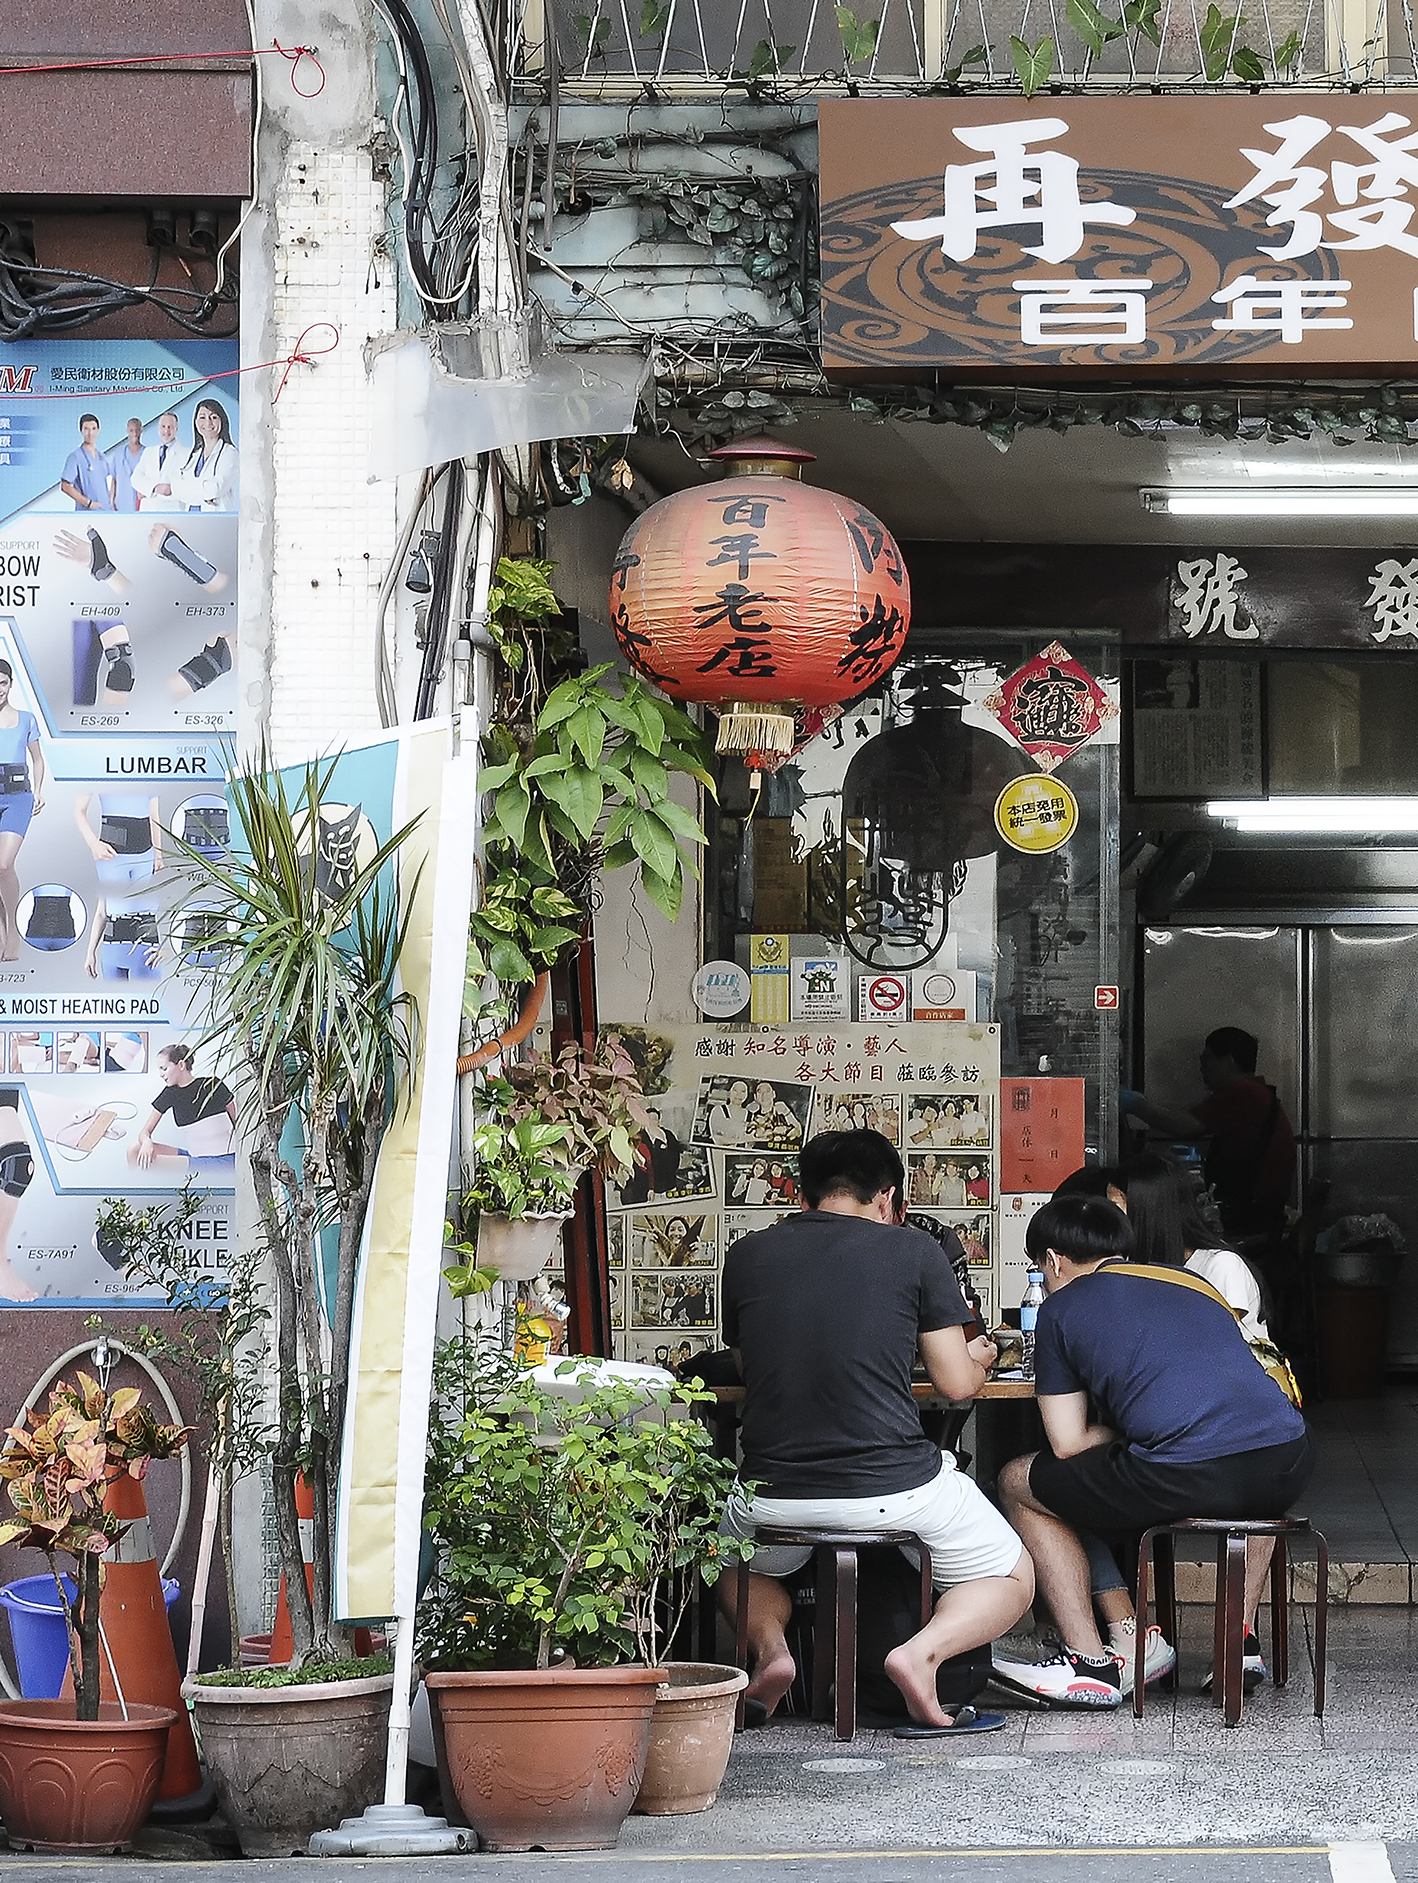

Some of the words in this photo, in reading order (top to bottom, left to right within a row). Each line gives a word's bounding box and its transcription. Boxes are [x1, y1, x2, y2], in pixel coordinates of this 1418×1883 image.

[692, 493, 787, 678] 百年老店
[80, 606, 121, 617] EH-409
[185, 606, 226, 617] EH-373
[80, 715, 120, 726] ES-269
[184, 715, 224, 726] ES-326
[105, 756, 208, 775] LUMBAR
[1006, 797, 1065, 817] 本店免用
[1008, 810, 1068, 829] 統一發票
[12, 998, 58, 1015] MOIST
[62, 998, 126, 1015] HEATING
[130, 998, 160, 1015] PAD
[197, 1204, 229, 1215] PPORT
[28, 1249, 75, 1260] ES-7A91
